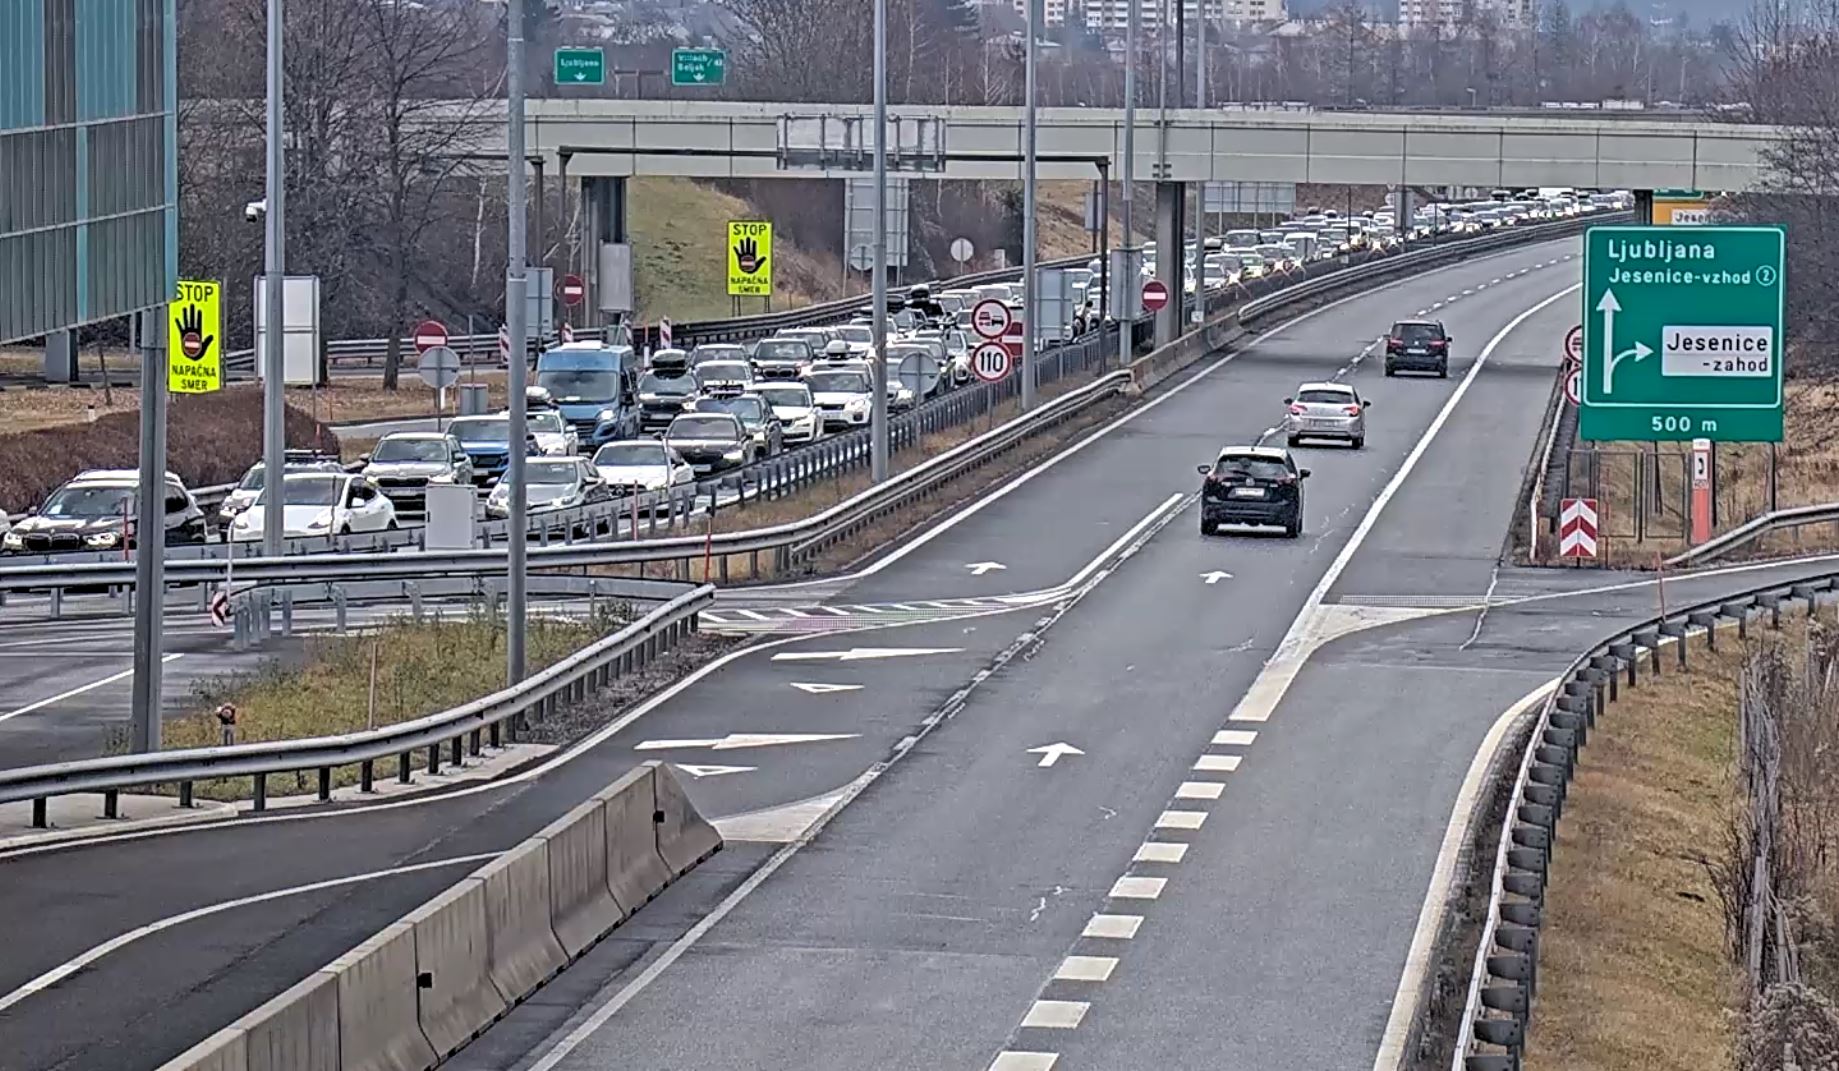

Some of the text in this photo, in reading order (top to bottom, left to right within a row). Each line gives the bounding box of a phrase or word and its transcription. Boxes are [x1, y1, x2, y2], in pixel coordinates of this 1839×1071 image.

[733, 223, 767, 236] STOP
[1608, 239, 1715, 263] Ljubljana
[1608, 267, 1751, 284] Jesenice-vzhod
[177, 284, 214, 302] STOP
[1666, 332, 1769, 352] Jesenice
[979, 351, 1004, 372] 110
[1702, 357, 1769, 373] -zahod
[171, 363, 217, 378] NAPAČNA
[180, 379, 208, 391] SMER
[1651, 416, 1718, 432] 500 m
